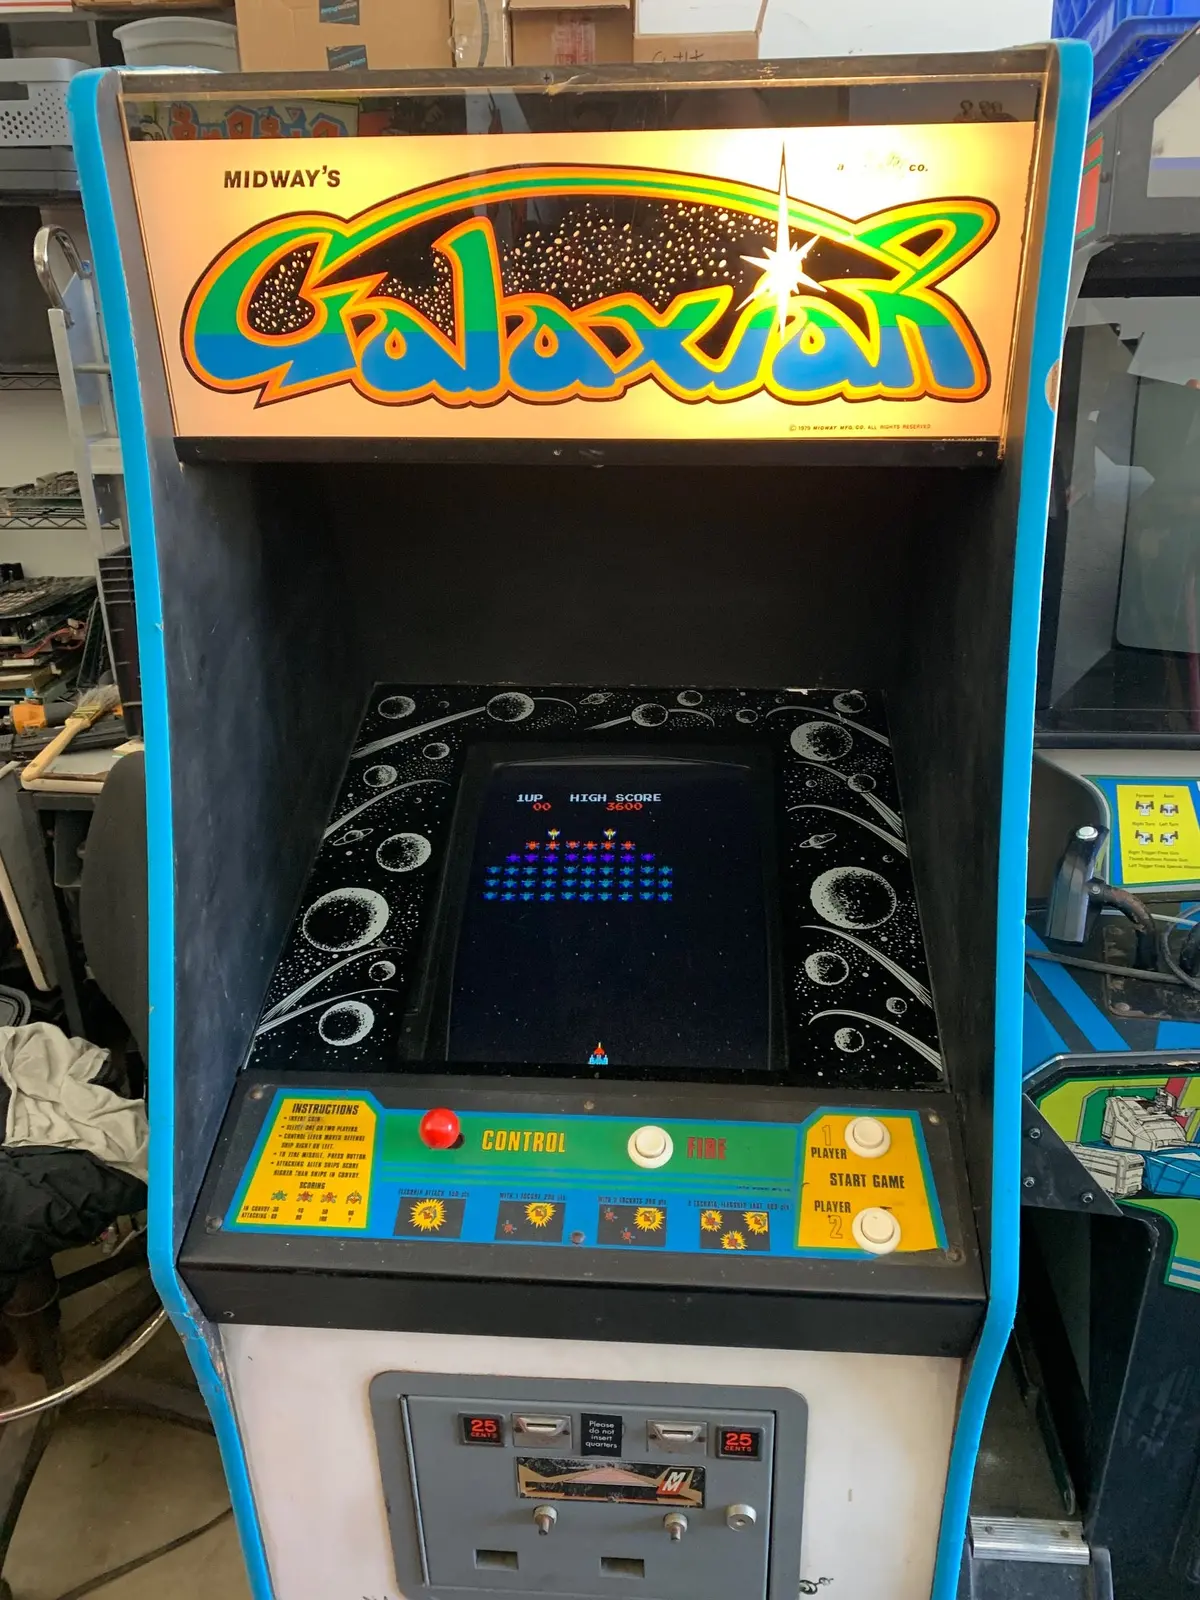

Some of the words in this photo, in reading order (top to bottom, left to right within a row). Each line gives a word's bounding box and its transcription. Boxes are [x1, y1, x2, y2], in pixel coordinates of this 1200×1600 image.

[224, 165, 341, 188] MIDWAY'S
[517, 794, 543, 802] 1UP
[570, 794, 606, 802] HIGH
[616, 793, 661, 802] SCORE
[533, 803, 551, 811] 00
[606, 803, 643, 811] 3600
[292, 1104, 359, 1115] INSTRUCTIONS
[482, 1130, 566, 1153] CONTROL
[822, 1125, 831, 1146] 1
[687, 1136, 727, 1160] FIRE
[811, 1147, 847, 1159] PLAYER
[830, 1173, 866, 1187] START
[873, 1175, 905, 1189] GAME
[814, 1200, 851, 1213] PLAYER
[829, 1215, 843, 1239] 2
[471, 1419, 496, 1432] 25
[589, 1420, 614, 1428] Please
[726, 1433, 752, 1446] 25
